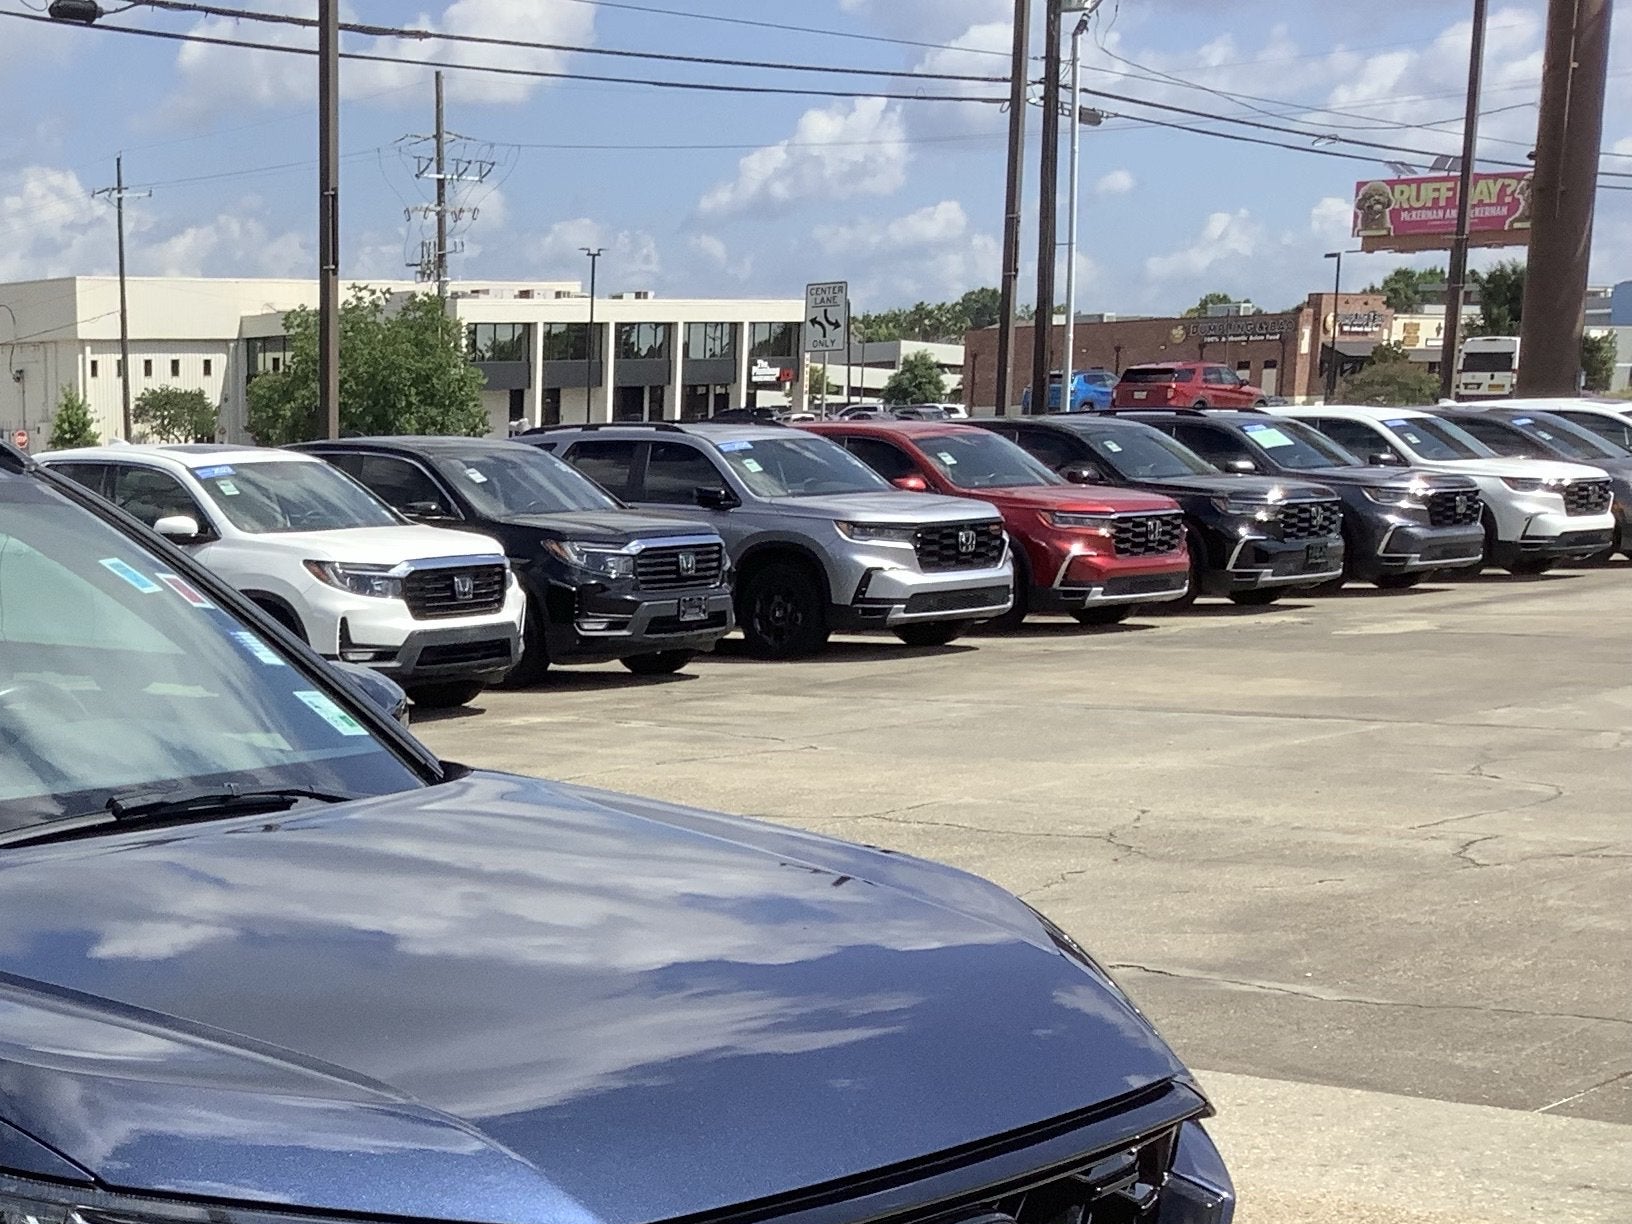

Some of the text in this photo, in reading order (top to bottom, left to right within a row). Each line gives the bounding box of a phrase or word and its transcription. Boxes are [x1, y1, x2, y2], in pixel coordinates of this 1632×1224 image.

[1393, 178, 1517, 208] RUFF AY?
[1470, 206, 1508, 218] cKERNAN
[809, 286, 844, 296] CENTER
[814, 296, 838, 305] LANE
[812, 338, 836, 348] ONLY
